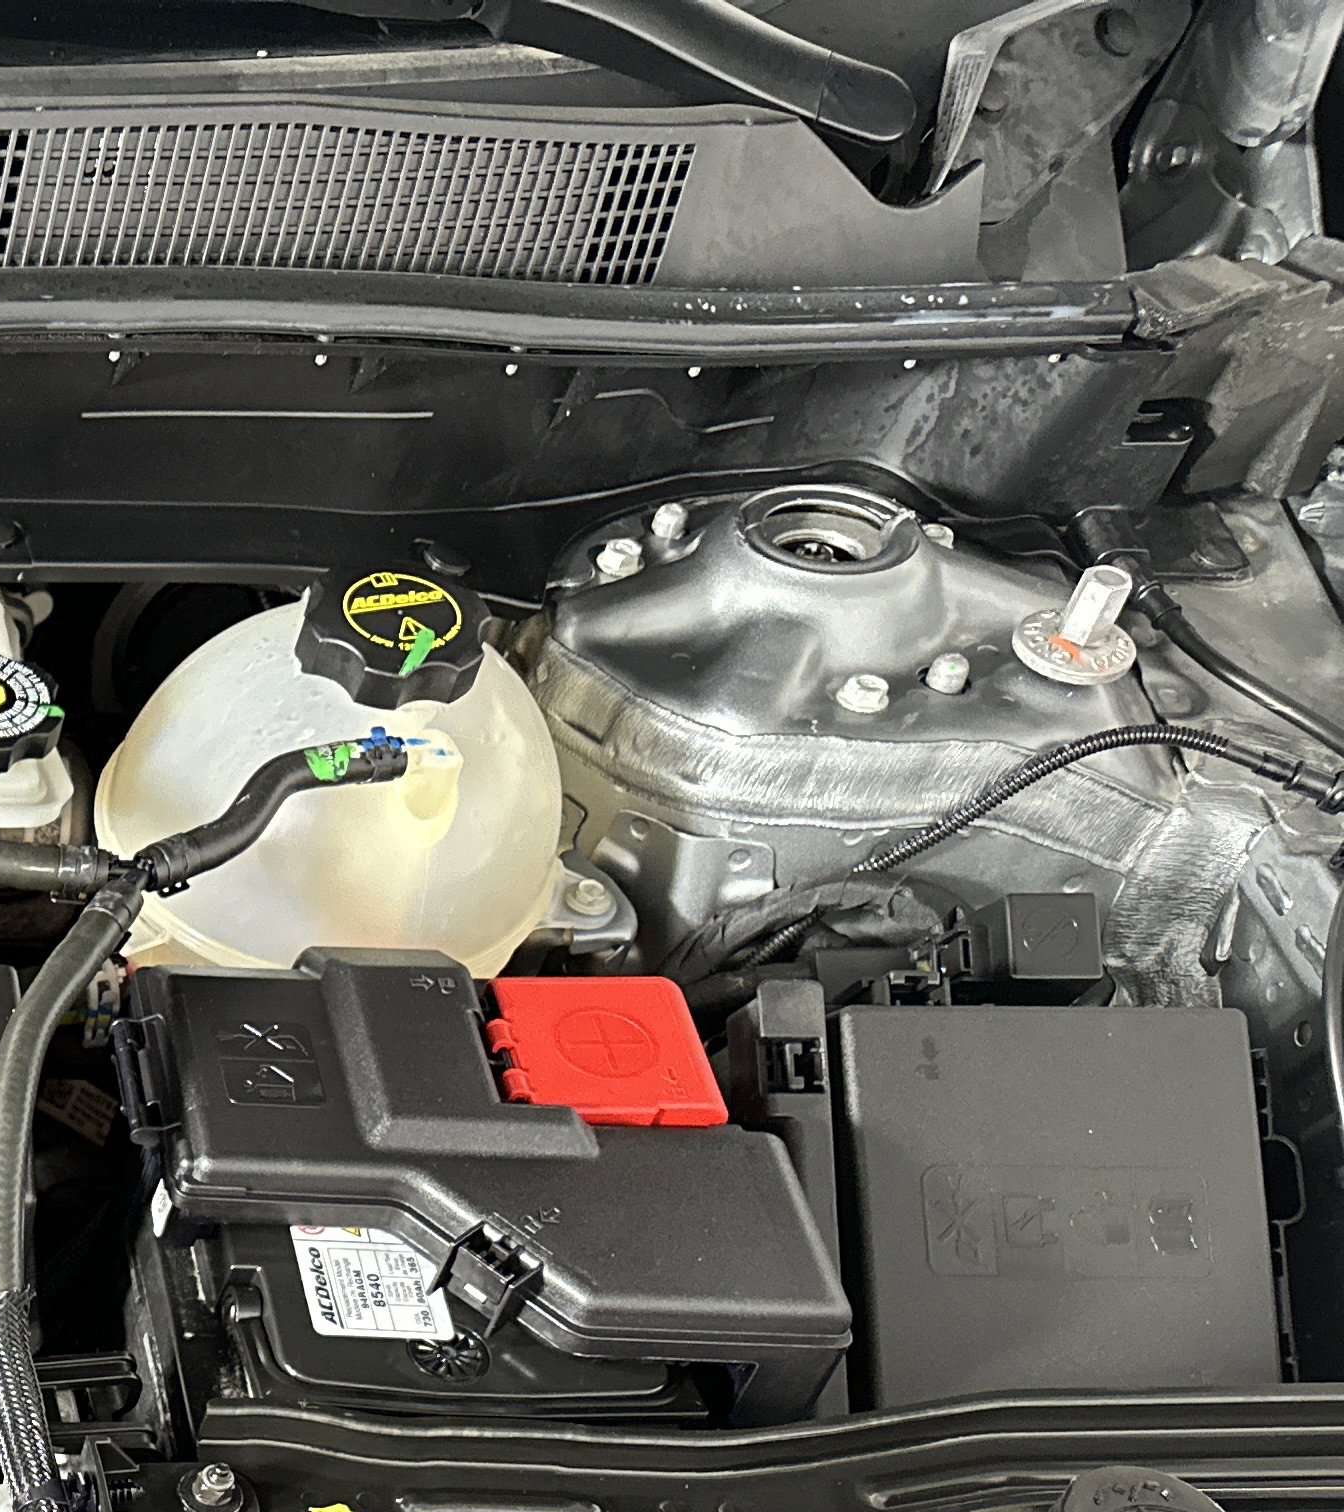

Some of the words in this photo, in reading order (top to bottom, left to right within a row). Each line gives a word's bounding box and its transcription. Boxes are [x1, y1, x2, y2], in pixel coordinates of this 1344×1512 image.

[351, 591, 443, 609] ACDelco
[308, 1247, 337, 1325] ACDelco
[367, 1273, 387, 1307] 8540
[421, 1310, 433, 1327] 730
